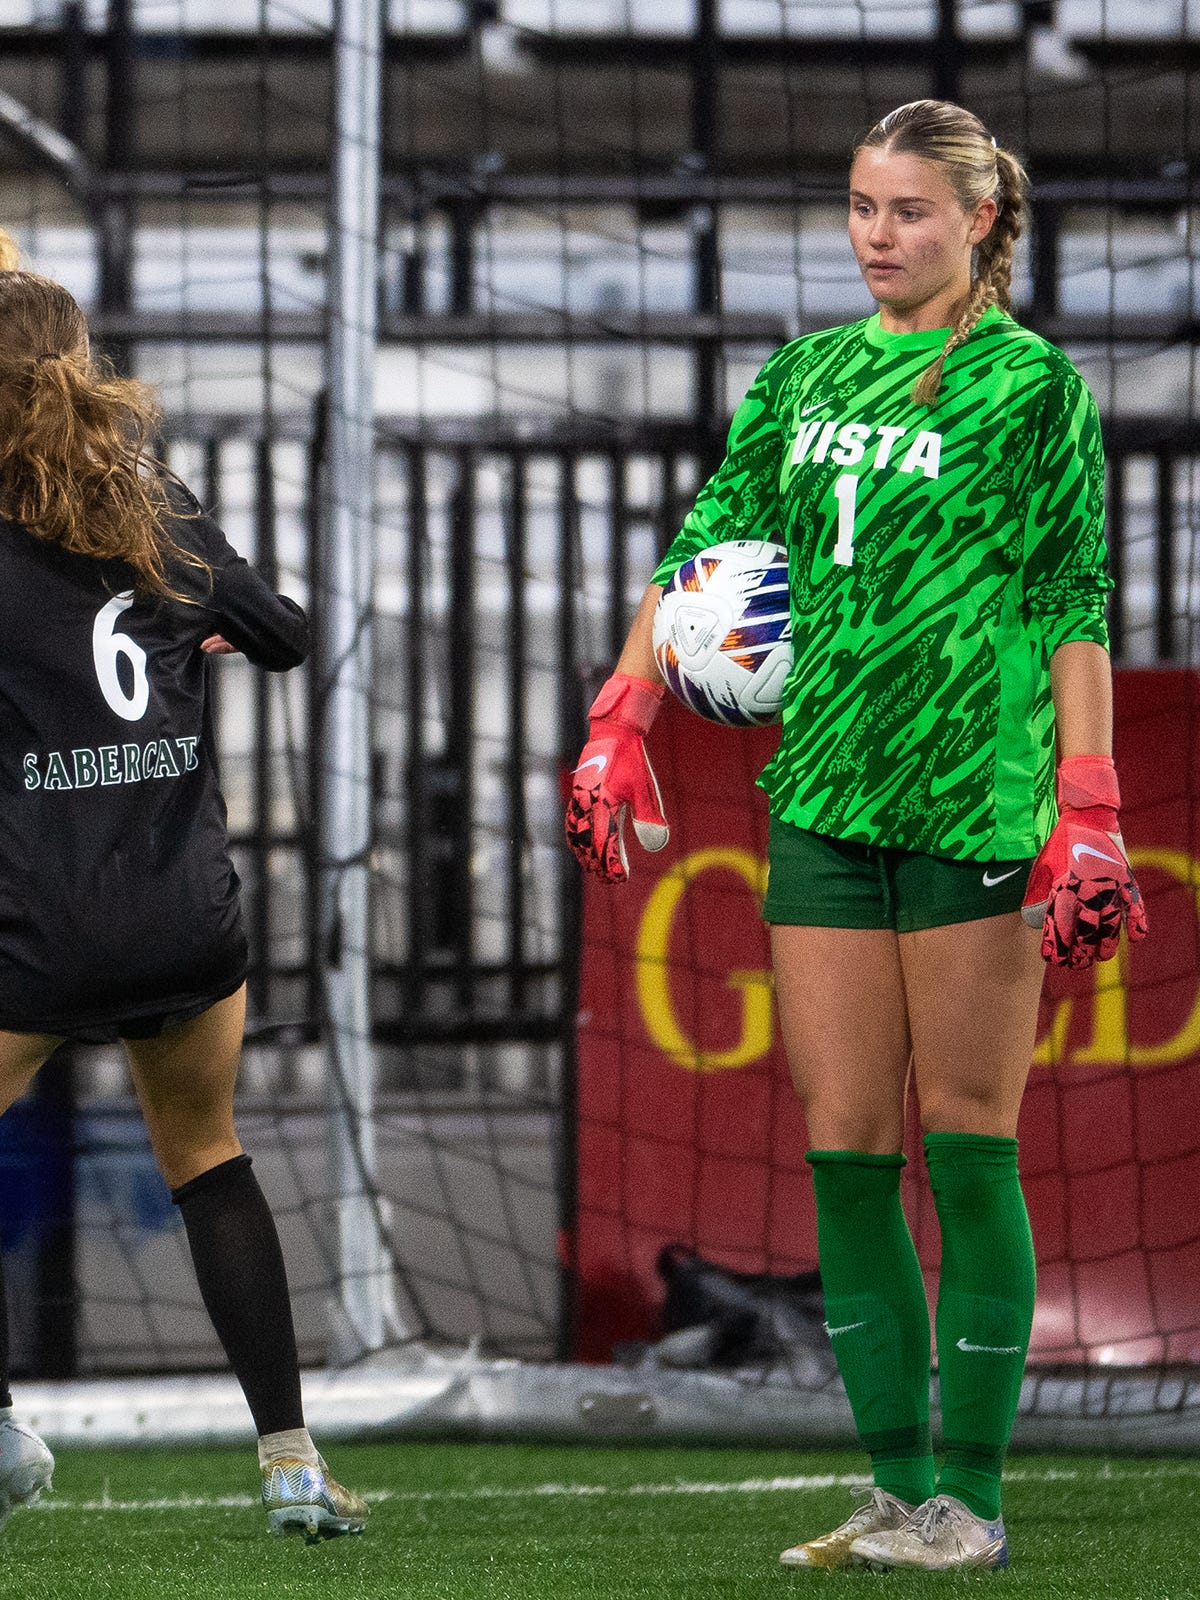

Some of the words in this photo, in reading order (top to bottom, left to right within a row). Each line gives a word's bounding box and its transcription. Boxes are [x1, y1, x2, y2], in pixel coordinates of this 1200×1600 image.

[791, 421, 942, 480] VISTA
[834, 473, 859, 567] 1
[92, 589, 150, 722] 6
[23, 735, 201, 791] SABERCAT
